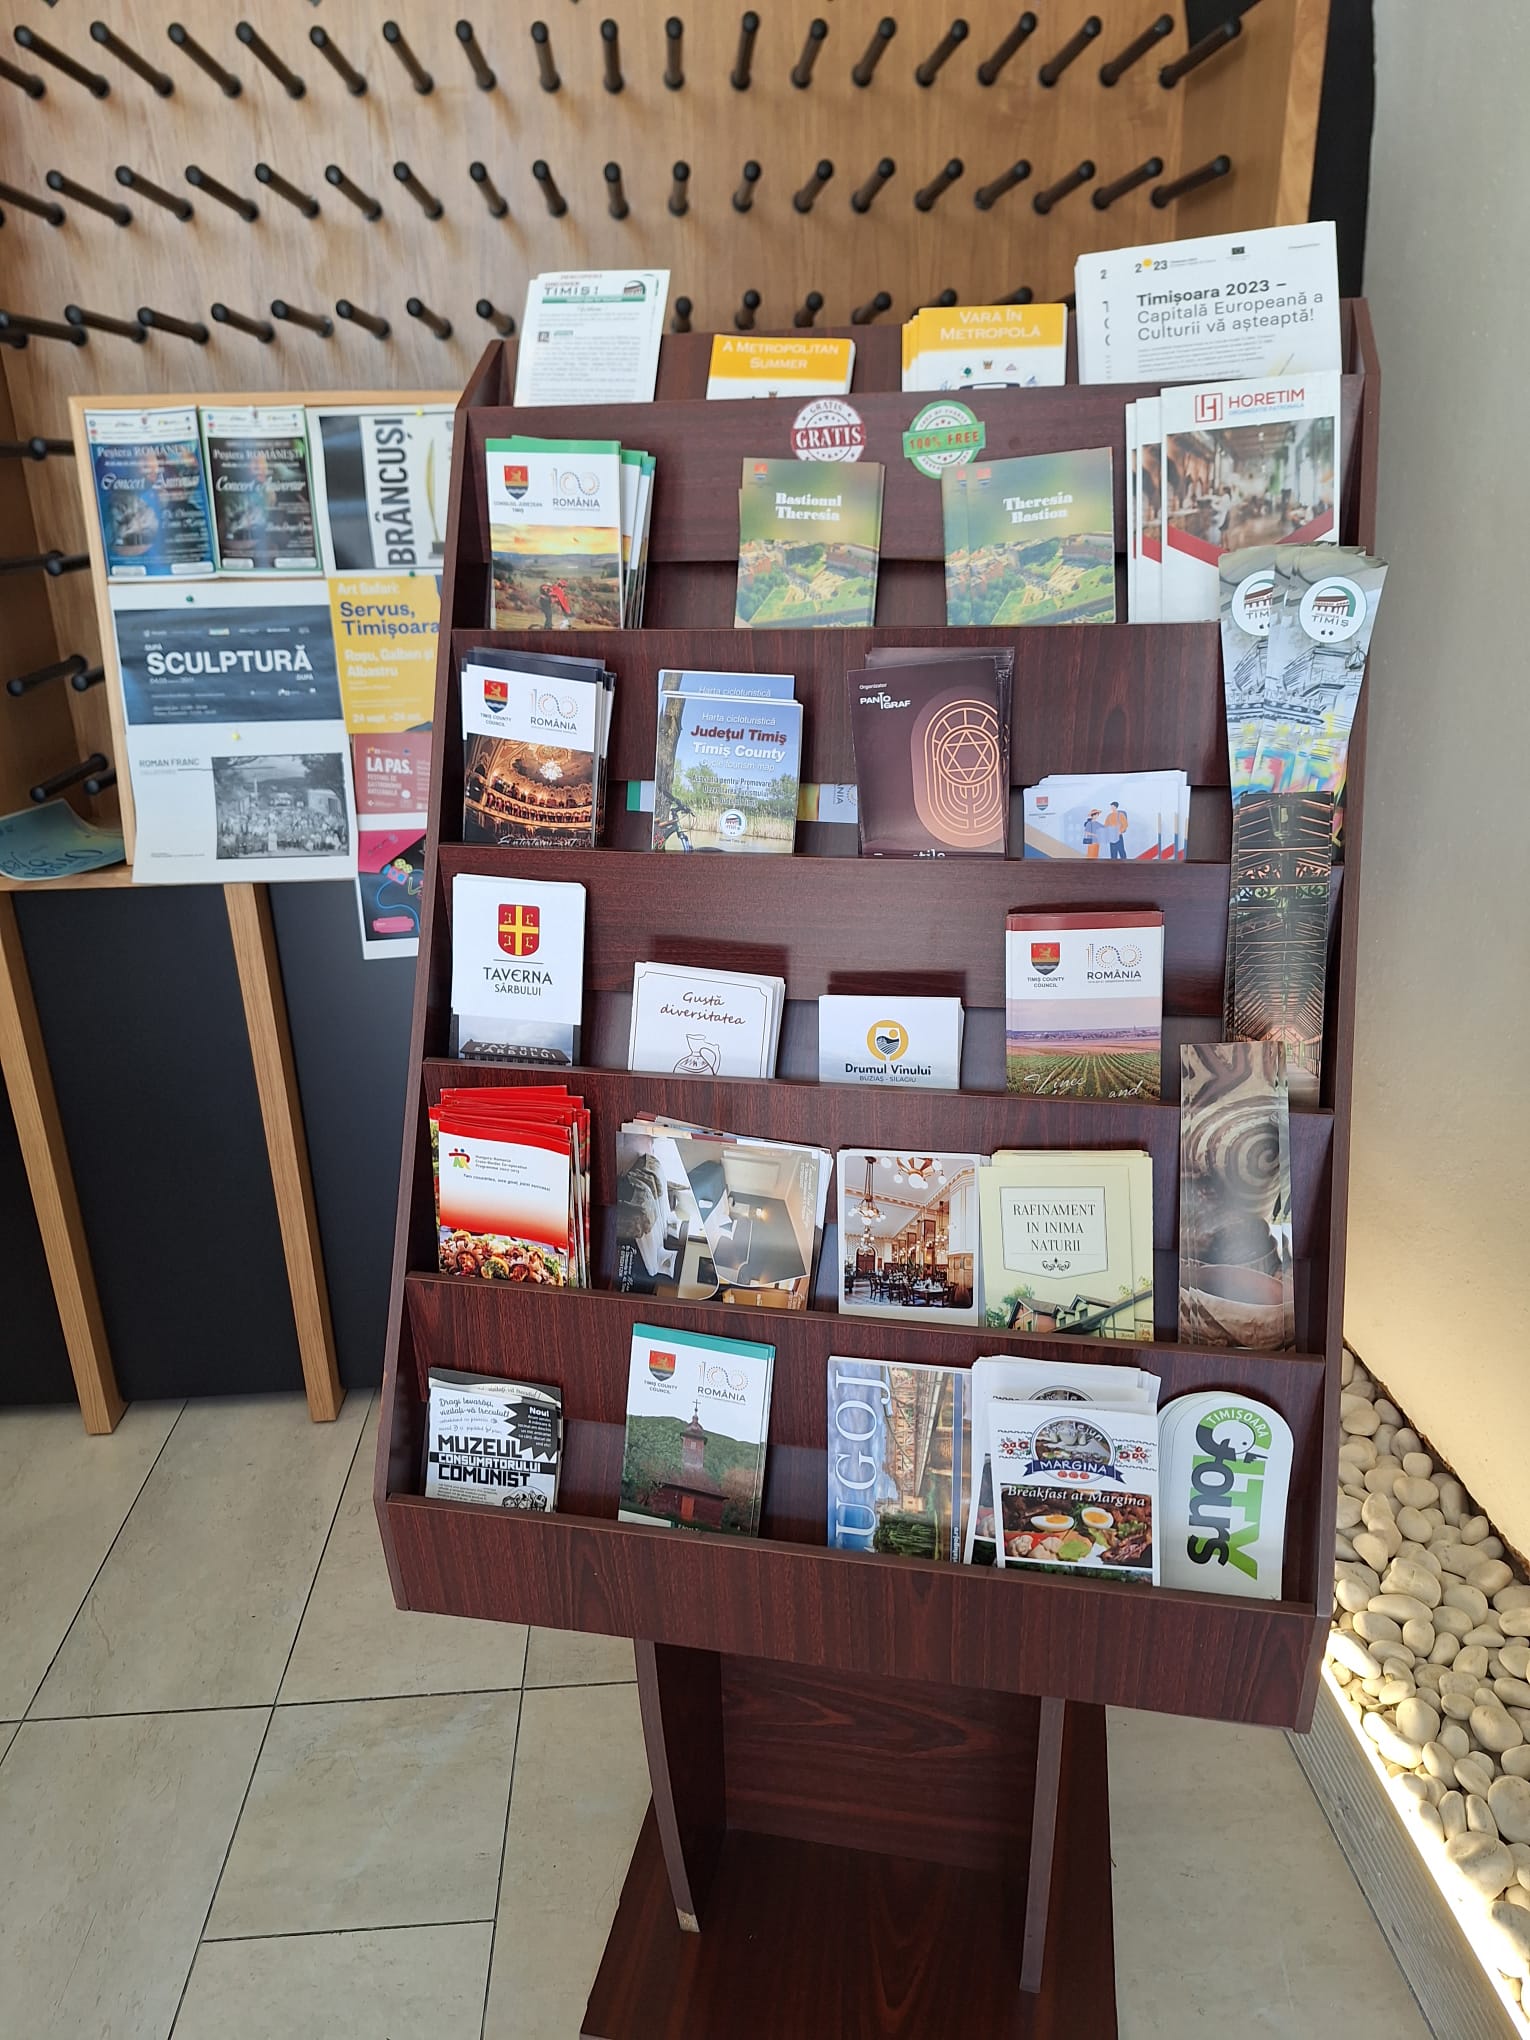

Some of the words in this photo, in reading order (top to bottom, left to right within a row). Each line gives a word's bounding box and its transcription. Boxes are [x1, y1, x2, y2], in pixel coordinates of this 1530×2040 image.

[1136, 288, 1221, 307] Timișoara
[1225, 279, 1271, 296] 2023
[1137, 304, 1209, 328] Capitală
[1214, 290, 1309, 319] Europeană
[1313, 291, 1324, 303] a
[1137, 320, 1202, 341] Culturii
[1206, 318, 1227, 333] vă
[1232, 308, 1315, 331] așteaptă!
[722, 341, 734, 352] A
[736, 341, 839, 356] METROPOLITAN
[749, 357, 808, 369] SUMMER
[810, 401, 844, 413] GRATIS
[1228, 388, 1305, 409] HORETIM
[796, 426, 862, 449] GRATIS
[947, 430, 979, 446] FREE
[374, 418, 417, 566] BRÂNCUȘI
[775, 492, 842, 507] Bastionul
[552, 496, 600, 508] ROMÂNIA
[1003, 491, 1073, 511] Theresia
[775, 506, 840, 521] Theresia
[1011, 507, 1068, 524] Bastion
[340, 601, 415, 618] Servus,
[341, 619, 440, 638] Timișoara
[147, 645, 312, 675] SCULPTURĂ
[530, 717, 577, 731] ROMÂNIA
[702, 712, 724, 722] Harta
[749, 729, 787, 745] Timiș
[693, 742, 730, 757] Timiș
[734, 744, 785, 762] County
[367, 756, 384, 772] LA
[385, 757, 413, 774] PAS.
[482, 966, 553, 985] TAVERNA
[1087, 969, 1142, 980] ROMÂNIA
[682, 991, 725, 1006] Gustă
[660, 1004, 745, 1025] diversitatea
[845, 1063, 887, 1074] Drumul
[891, 1064, 932, 1075] Vinului
[1109, 1081, 1144, 1098] and
[1013, 1203, 1096, 1217] RAFINAMENT
[1026, 1221, 1040, 1234] IN
[1045, 1221, 1085, 1234] INIMA
[1031, 1239, 1081, 1252] NATURII
[657, 1383, 678, 1391] COUNTY
[697, 1386, 746, 1402] ROMÂNIA
[1206, 1409, 1270, 1439] TIMISOARA
[438, 1435, 522, 1458] MUZEUL
[438, 1454, 541, 1472] CONSUMATORULUI
[1040, 1460, 1107, 1474] MARGINA
[438, 1464, 530, 1487] COMUNIST
[1008, 1486, 1068, 1501] Breakfast
[1071, 1493, 1084, 1501] at
[1088, 1491, 1146, 1507] Margina
